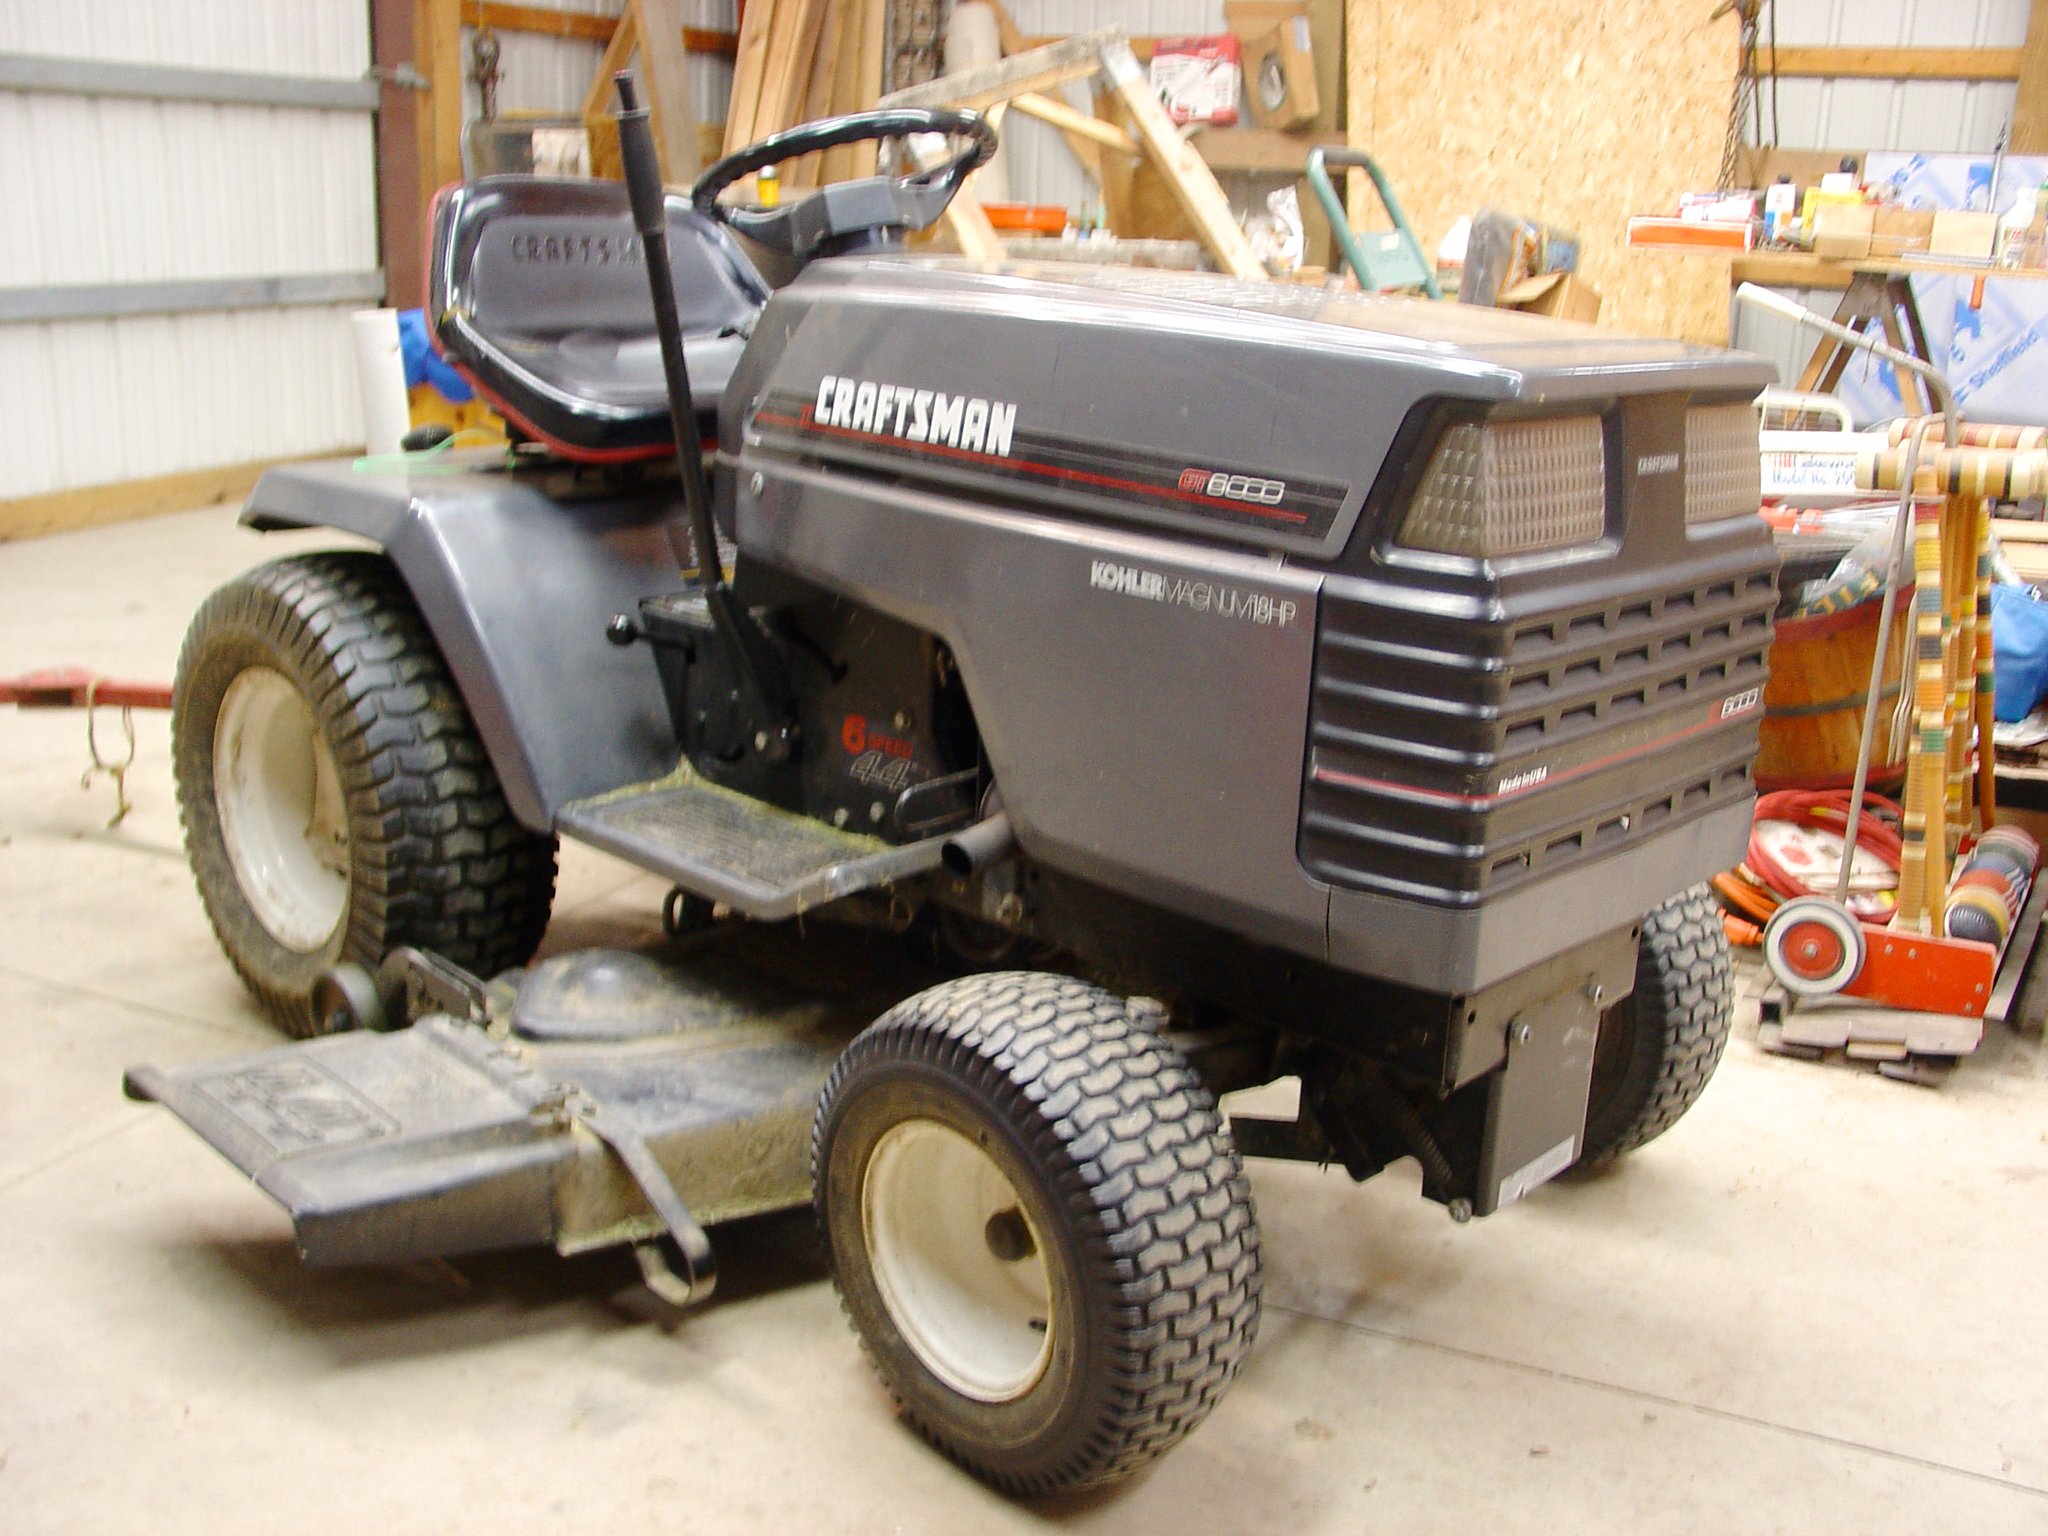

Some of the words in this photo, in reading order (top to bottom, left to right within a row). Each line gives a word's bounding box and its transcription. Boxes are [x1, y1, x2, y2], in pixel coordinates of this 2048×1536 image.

[814, 374, 1018, 458] CRAFTSMAN
[1090, 560, 1164, 602] KOHLER
[1162, 575, 1251, 621] MAGNUM
[1721, 687, 1759, 720] 6000
[842, 713, 867, 757] 6
[1529, 765, 1548, 786] USA
